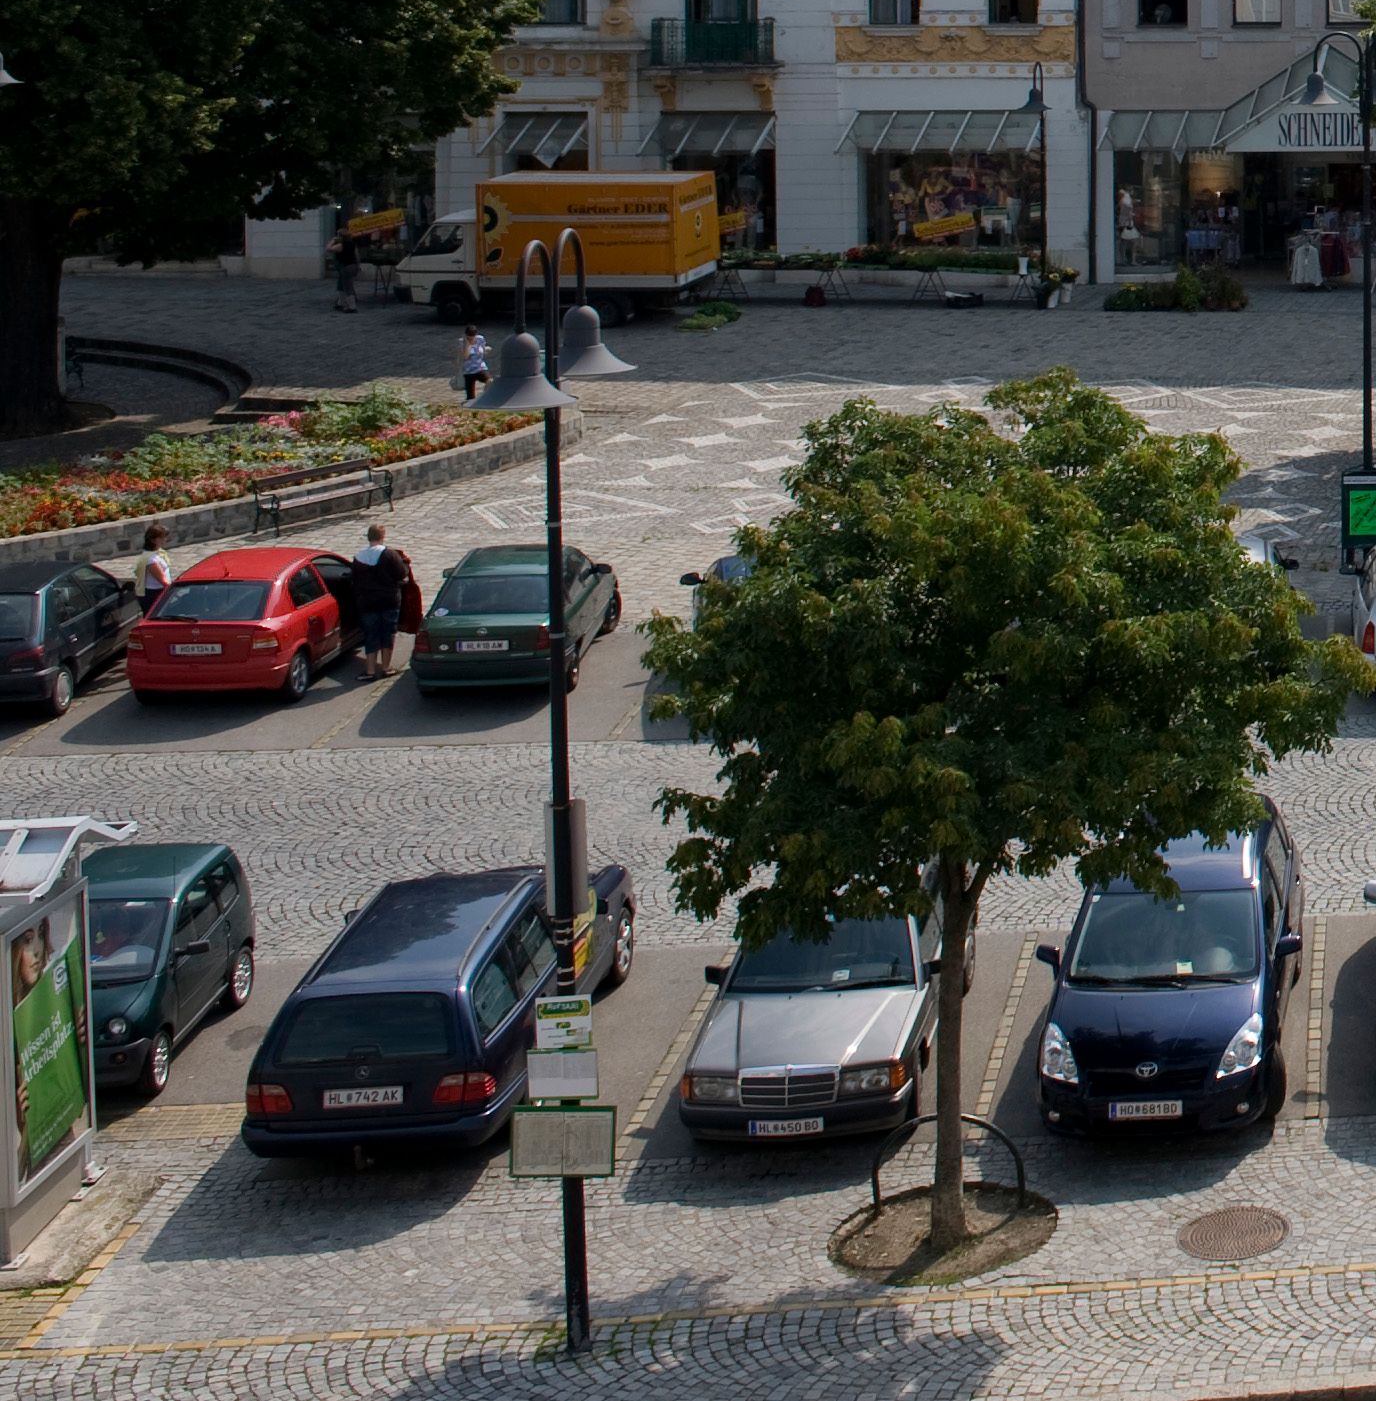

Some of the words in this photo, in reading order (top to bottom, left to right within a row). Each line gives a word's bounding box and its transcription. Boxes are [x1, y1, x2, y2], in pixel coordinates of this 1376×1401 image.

[624, 203, 669, 213] EDER
[20, 1024, 51, 1067] Wissen
[50, 1010, 63, 1028] ist
[328, 1093, 345, 1105] HL
[355, 1090, 379, 1103] 742
[383, 1089, 398, 1102] AK
[1142, 1104, 1161, 1114] 681
[759, 1123, 772, 1133] HL
[780, 1122, 801, 1133] 450
